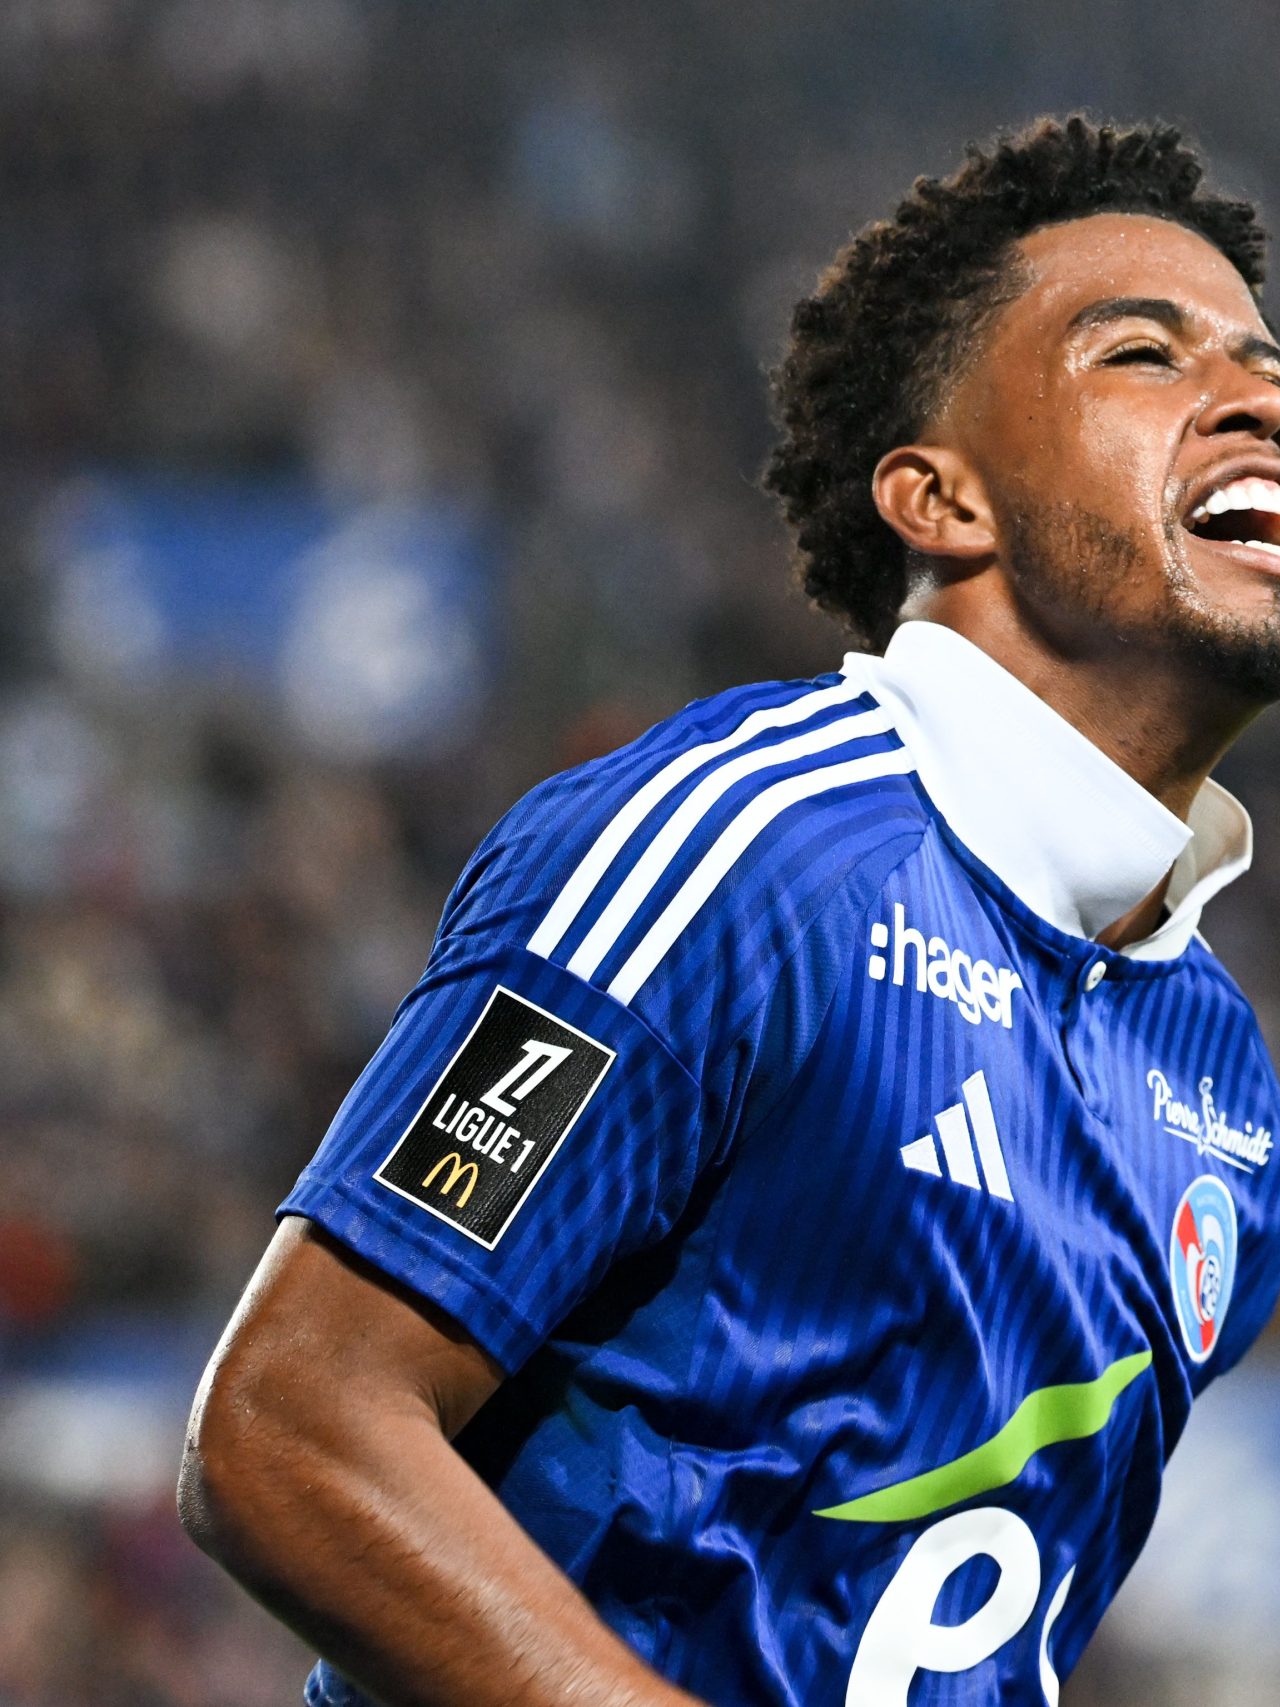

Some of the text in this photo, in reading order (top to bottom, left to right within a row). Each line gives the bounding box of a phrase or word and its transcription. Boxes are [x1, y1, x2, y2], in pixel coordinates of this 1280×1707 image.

[432, 1093, 536, 1174] LIGUE 1
[1146, 1069, 1274, 1166] Pierre Schmidt
